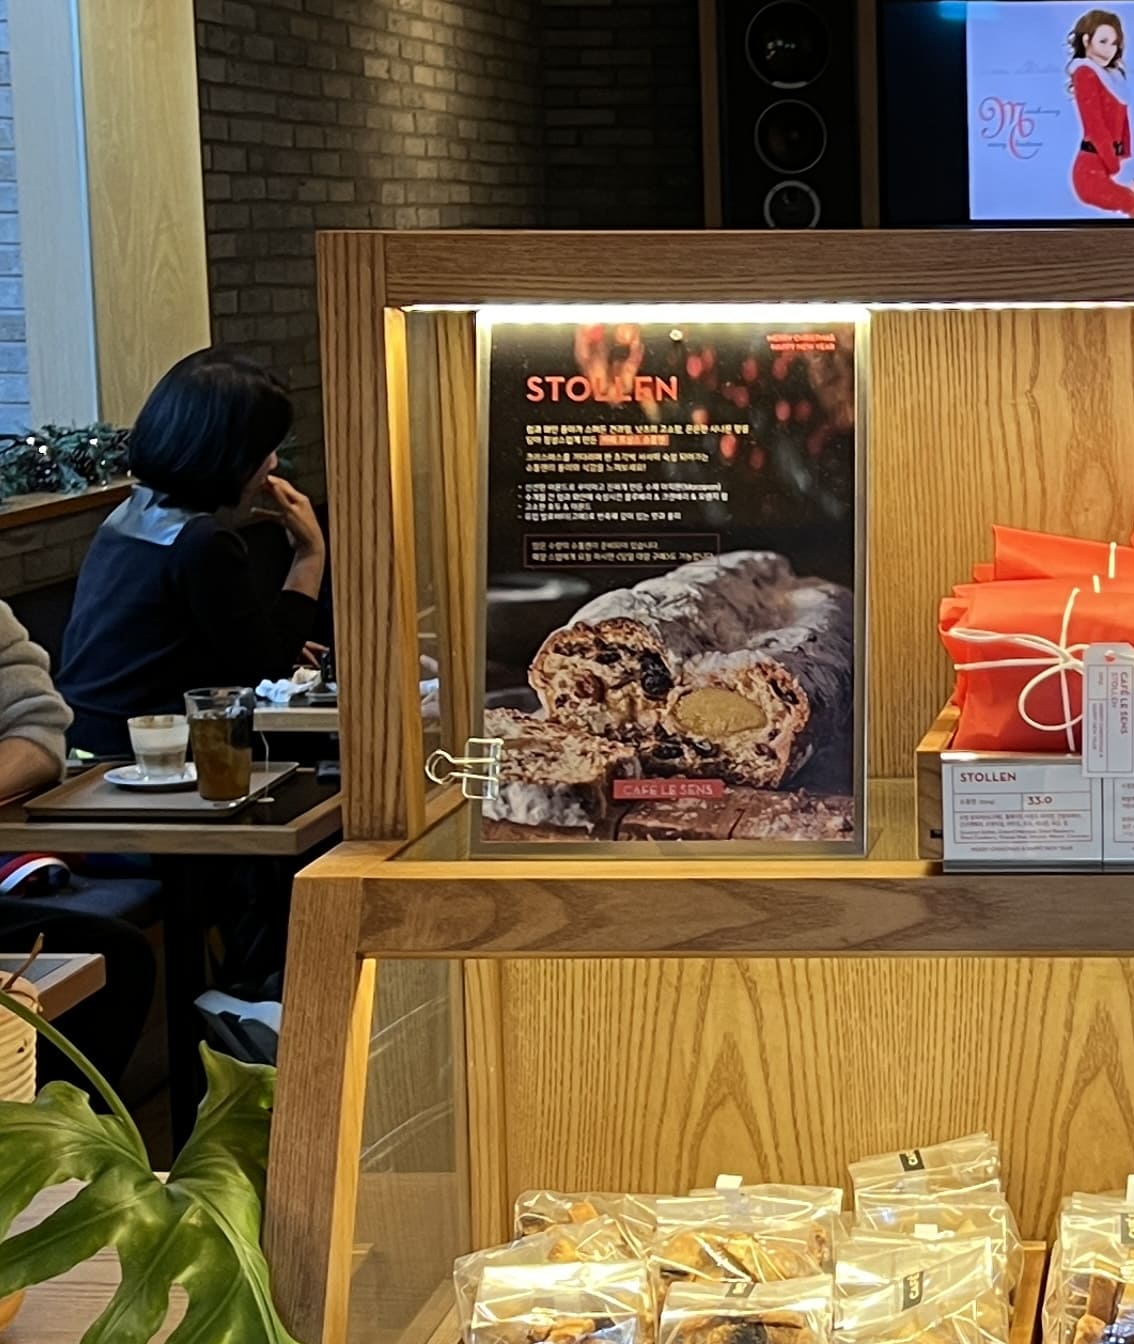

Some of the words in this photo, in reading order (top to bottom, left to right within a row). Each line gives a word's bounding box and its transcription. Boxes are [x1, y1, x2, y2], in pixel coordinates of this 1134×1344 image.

[526, 375, 678, 402] STOLLEN
[1120, 671, 1130, 695] CAFÉ
[1120, 697, 1129, 709] LE
[1120, 711, 1129, 734] SENS
[960, 772, 1017, 783] STOLLEN
[661, 784, 678, 796] LE
[679, 784, 713, 796] SENS
[1028, 796, 1053, 805] 33.0
